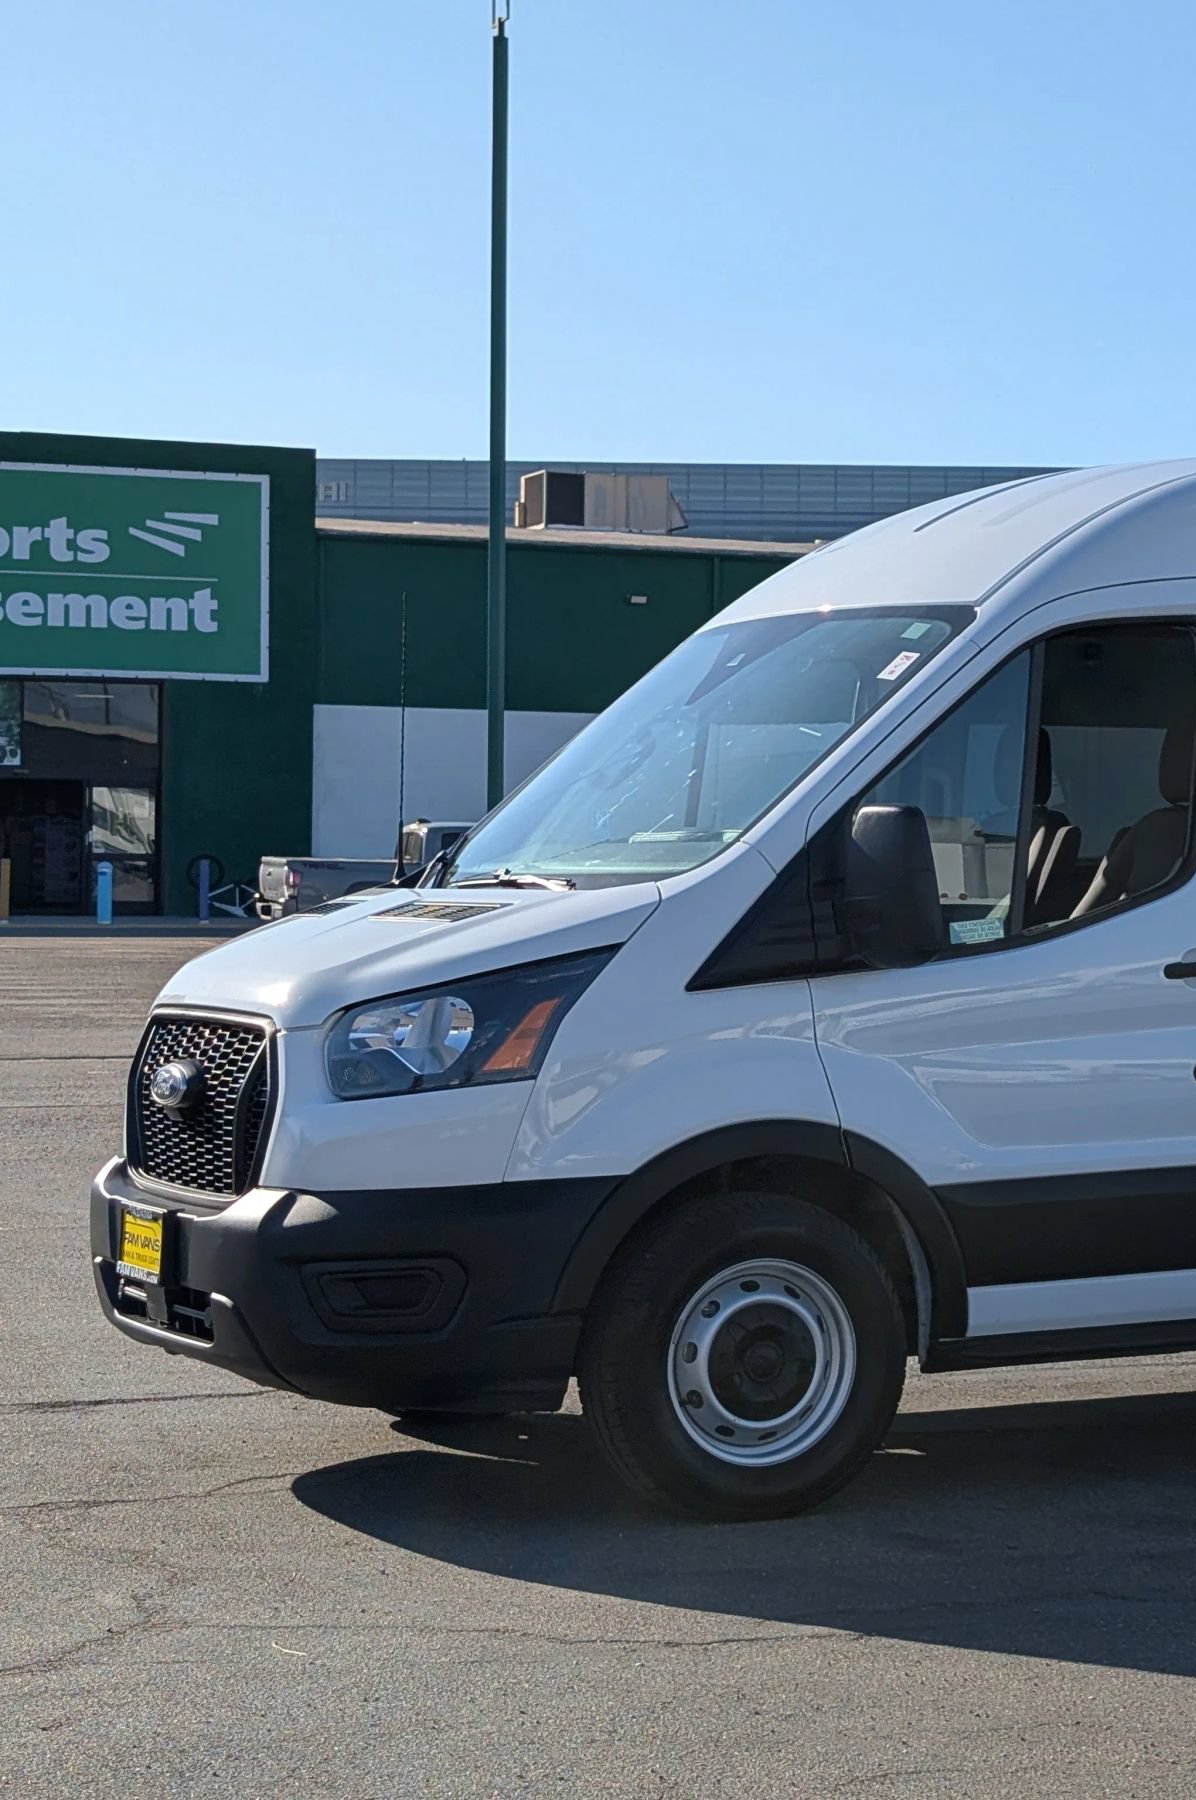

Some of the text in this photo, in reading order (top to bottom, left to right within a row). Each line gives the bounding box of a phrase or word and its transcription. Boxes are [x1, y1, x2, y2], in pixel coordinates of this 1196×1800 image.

[0, 516, 111, 563] rts
[0, 588, 219, 633] ement
[154, 1071, 174, 1095] Ford
